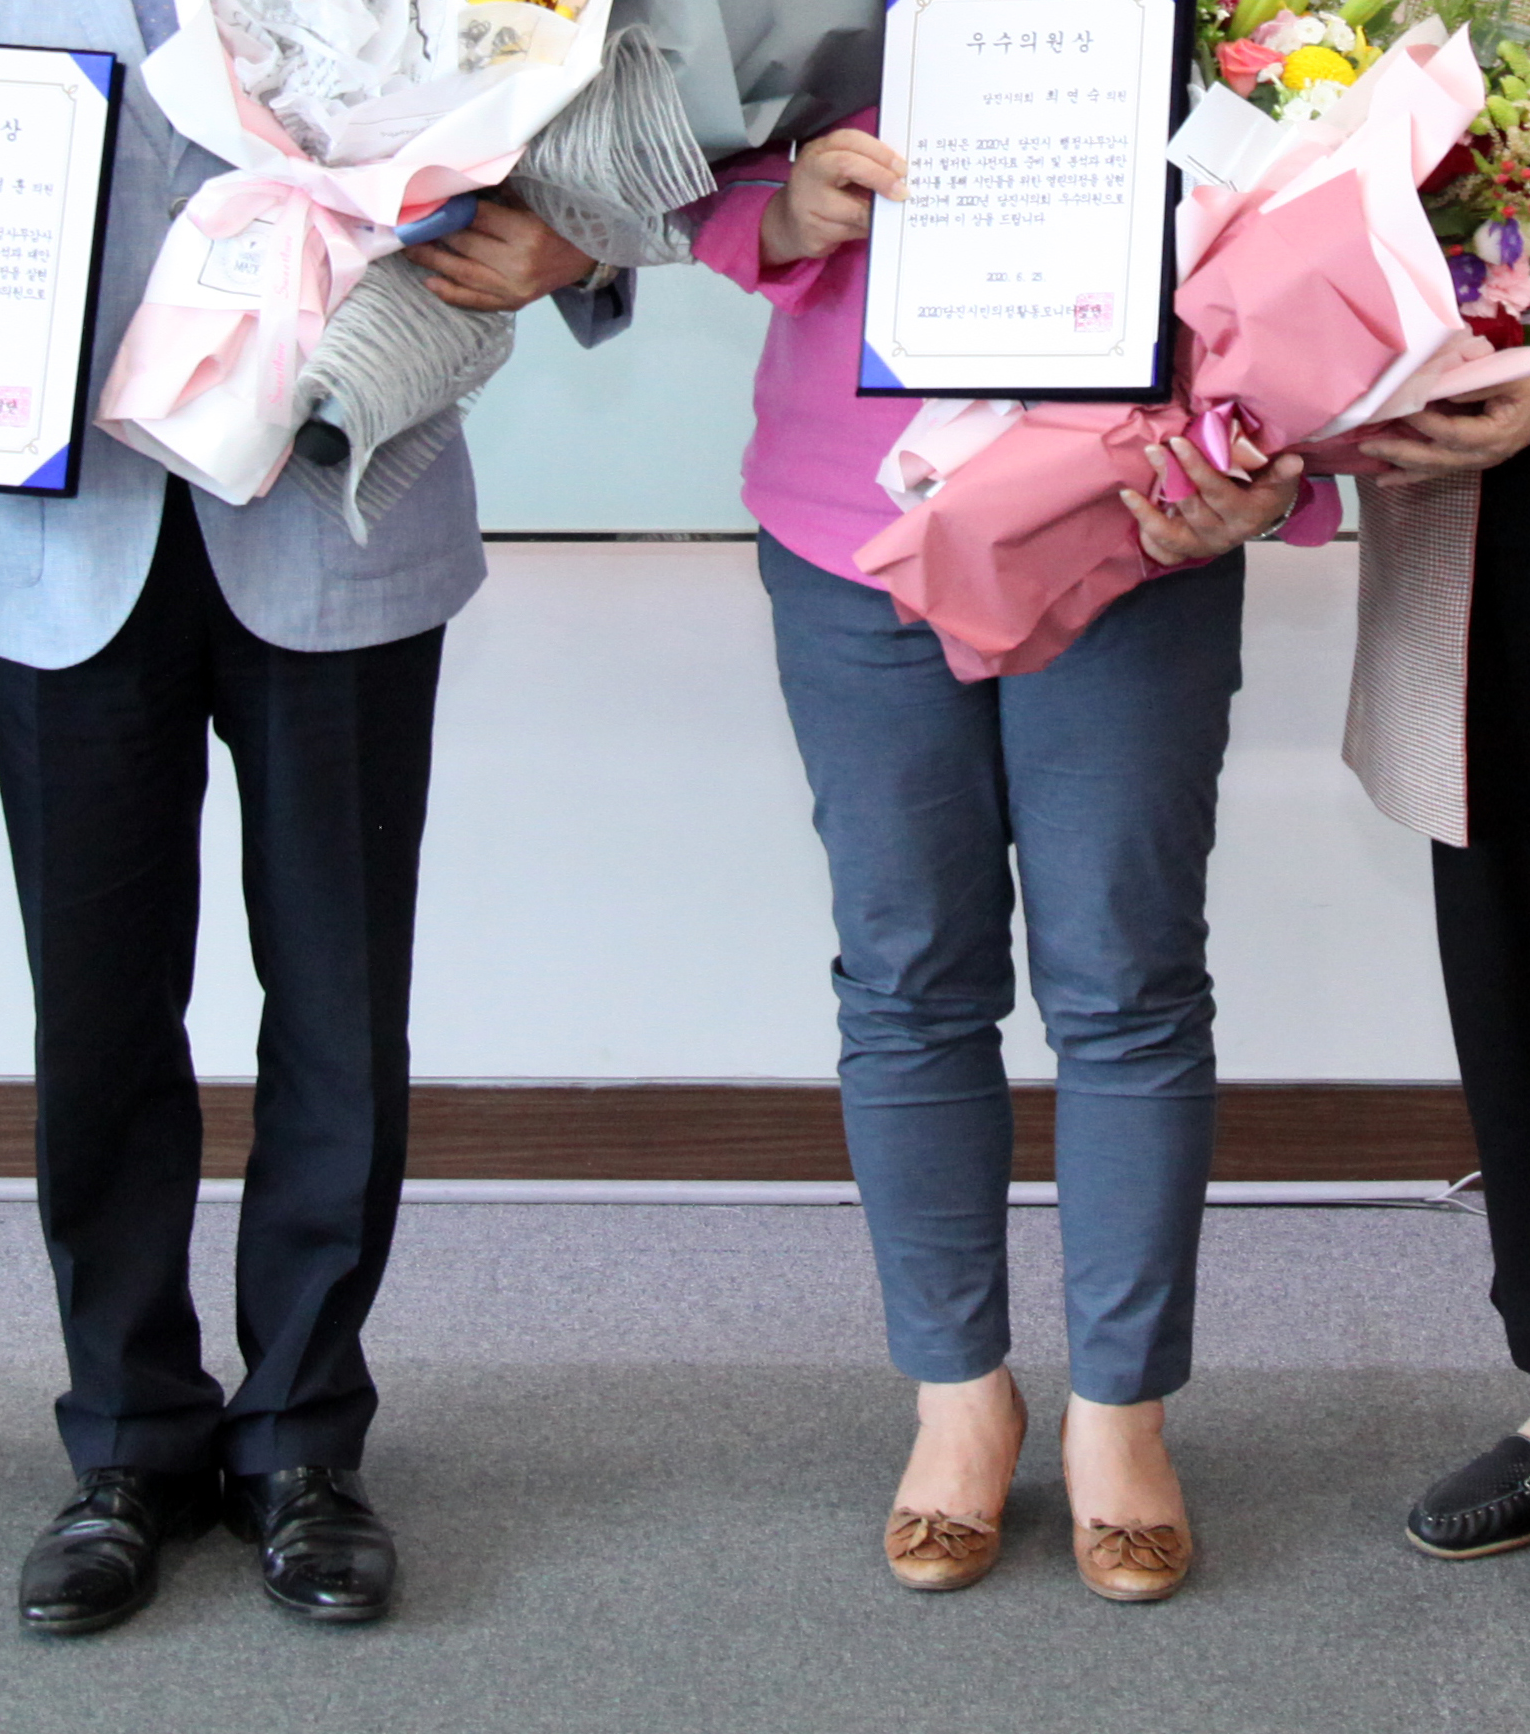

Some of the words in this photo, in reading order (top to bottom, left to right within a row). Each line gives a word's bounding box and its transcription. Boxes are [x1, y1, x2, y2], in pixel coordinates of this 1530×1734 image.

[976, 138, 1009, 151] 2020년
[1019, 137, 1051, 151] 당진시
[986, 272, 1010, 282] 2020.
